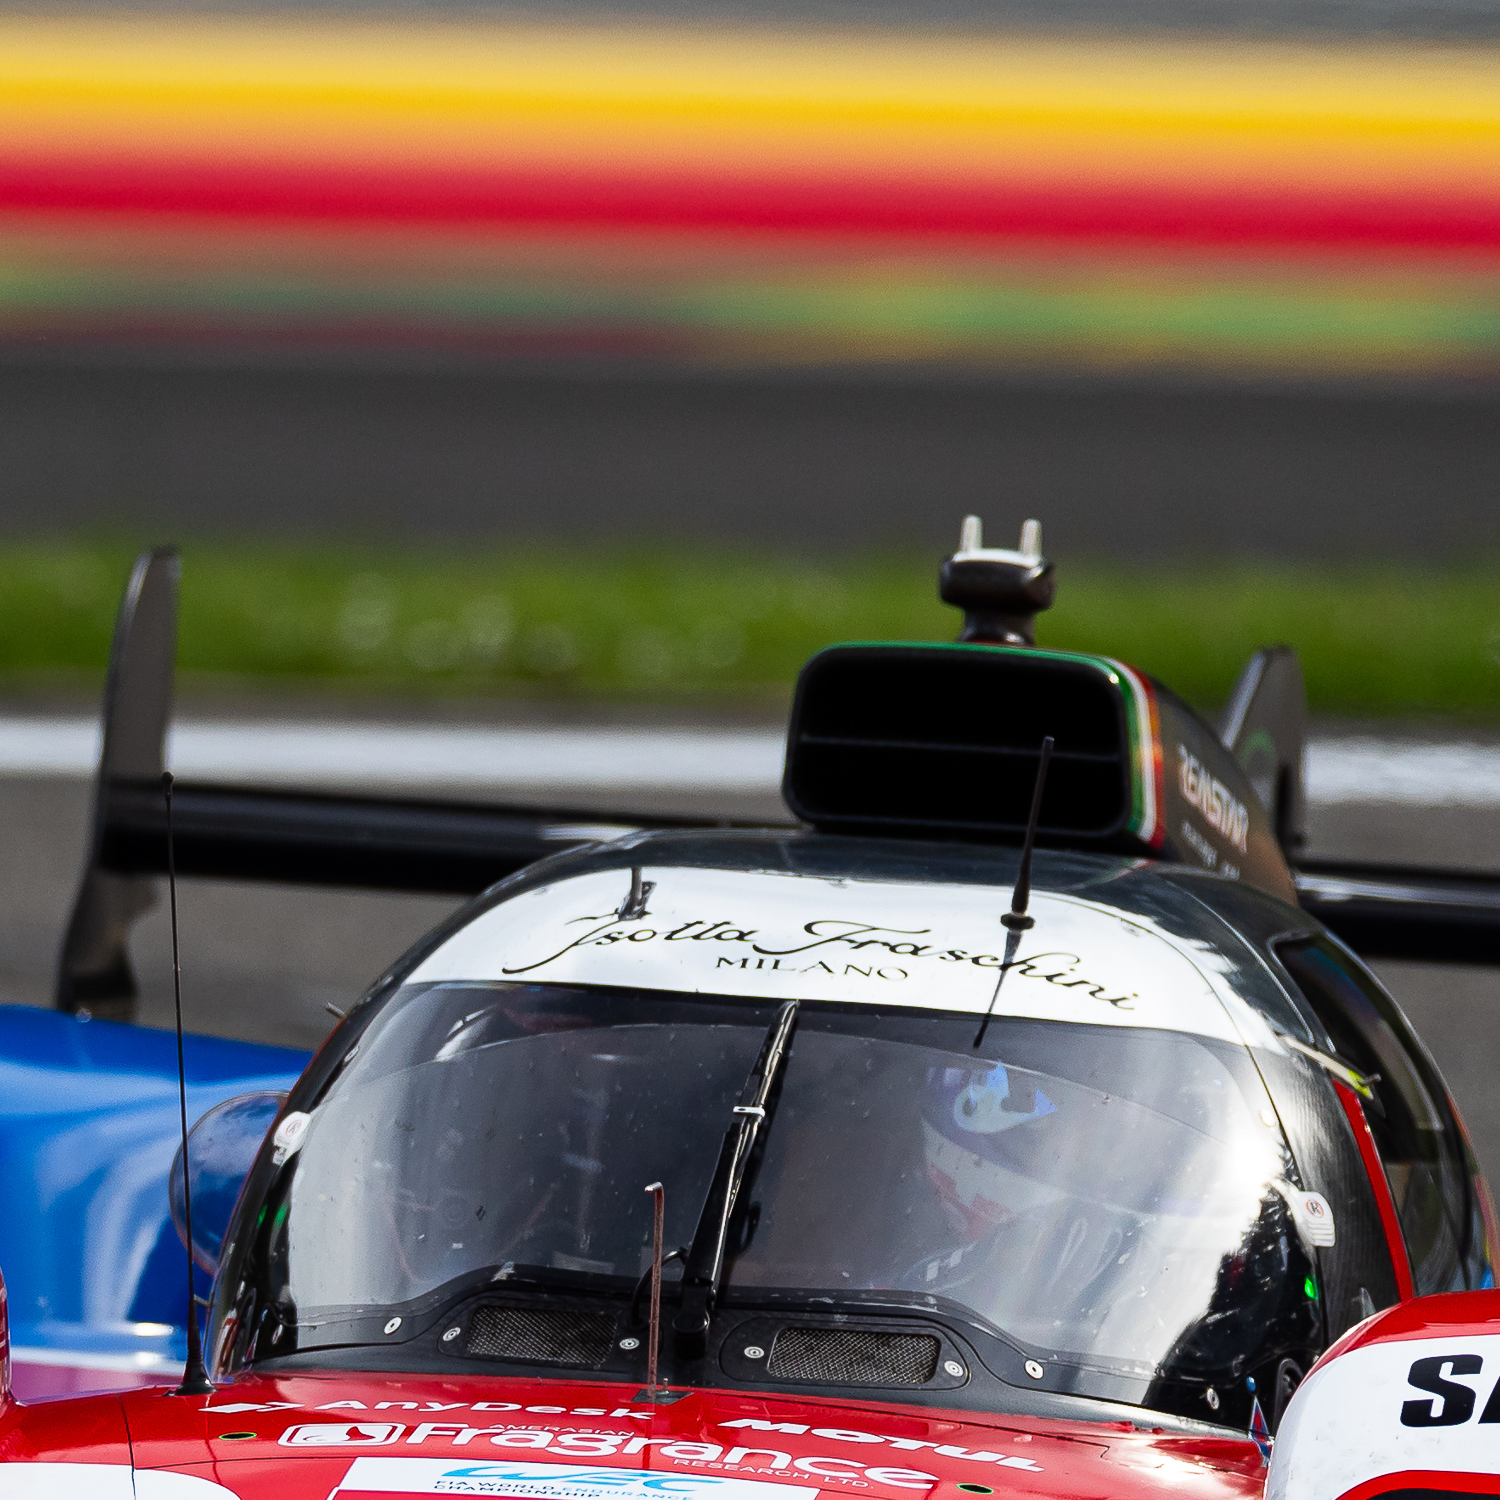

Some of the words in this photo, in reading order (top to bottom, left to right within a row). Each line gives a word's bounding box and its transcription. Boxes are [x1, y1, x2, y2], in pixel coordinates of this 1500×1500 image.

[715, 956, 909, 982] MILANO
[315, 1400, 656, 1422] AnyDesk
[490, 1423, 636, 1438] AMERASIAN
[405, 1422, 940, 1490] Fragrance
[717, 1418, 1046, 1473] MOTUL
[673, 1458, 809, 1480] RESEARCH
[433, 1484, 602, 1499] CHAMPIONSHIP
[436, 1480, 468, 1489] FIA
[478, 1482, 555, 1492] WORLD
